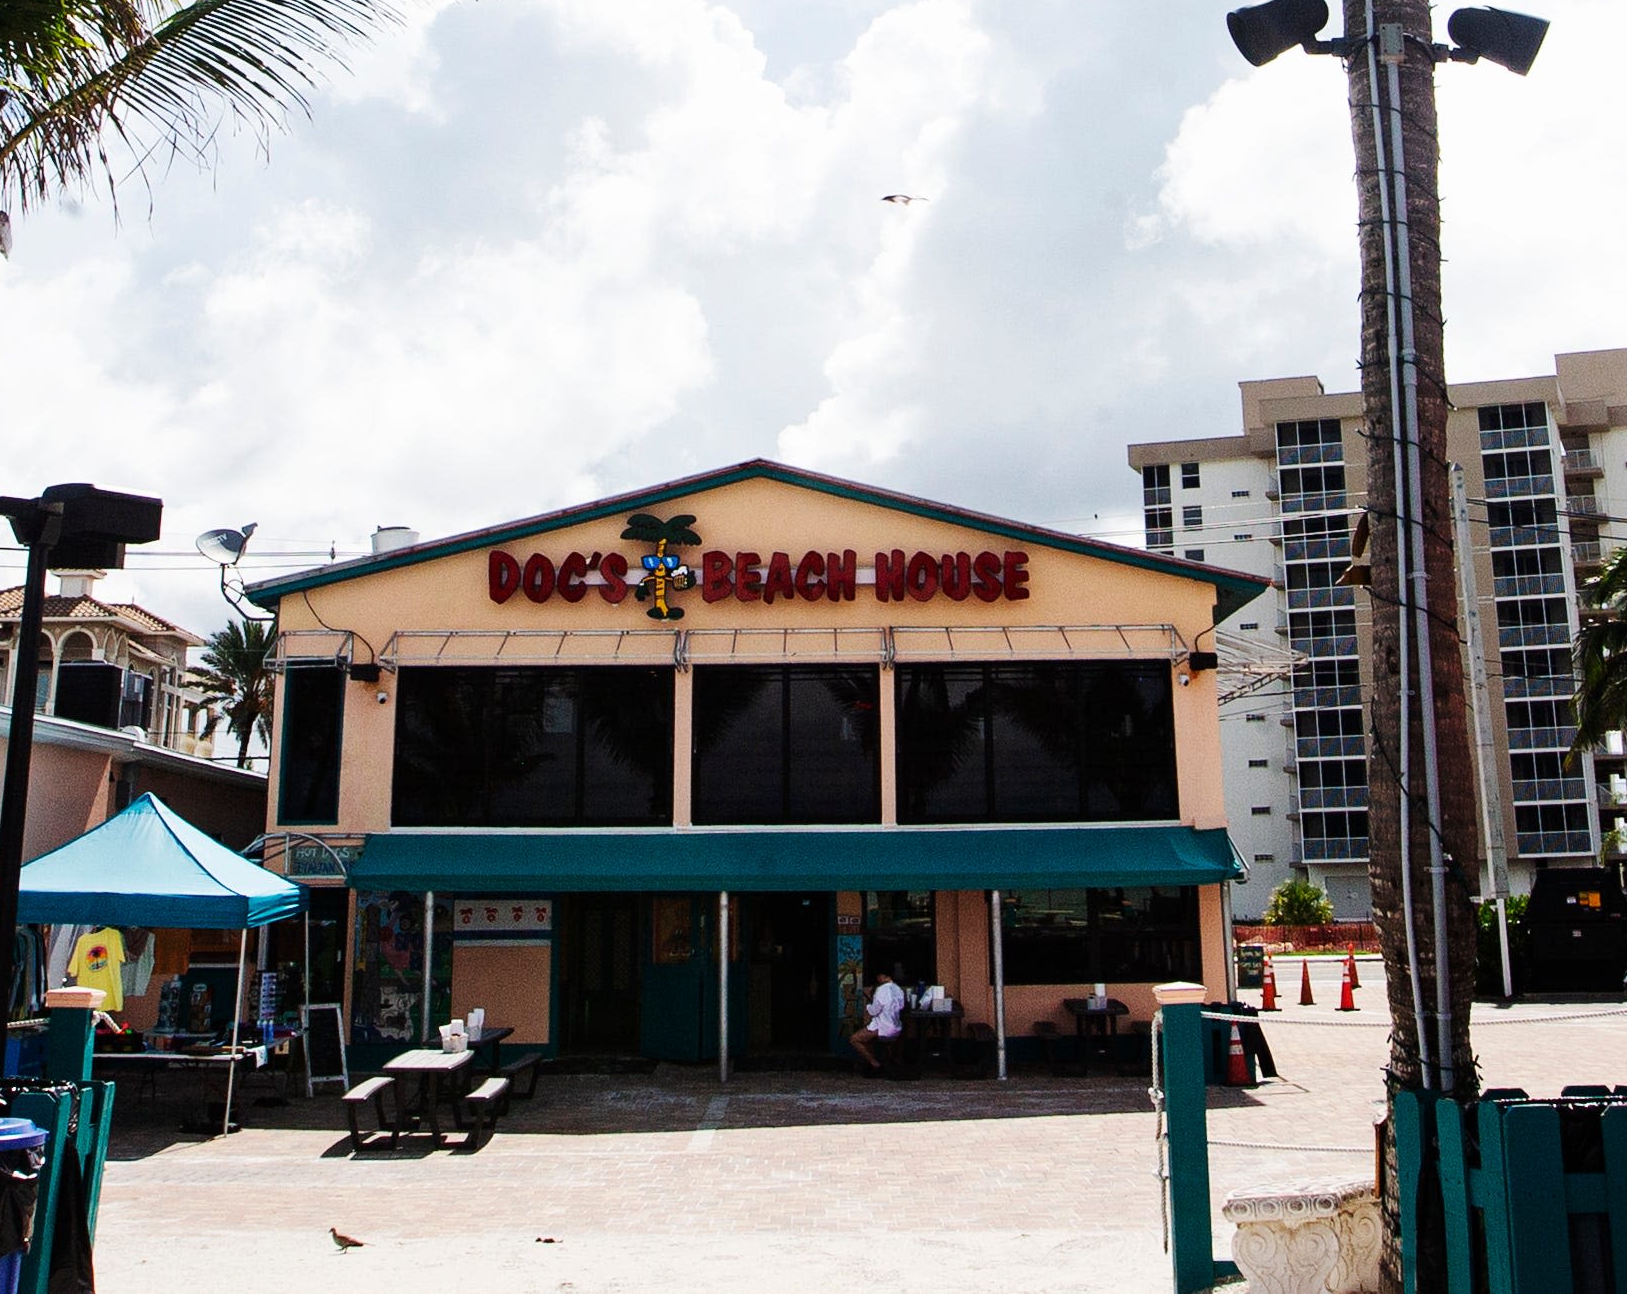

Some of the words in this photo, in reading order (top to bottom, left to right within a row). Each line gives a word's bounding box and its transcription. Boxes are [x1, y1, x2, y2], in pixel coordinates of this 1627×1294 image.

[488, 549, 628, 605] DOC'S
[701, 548, 857, 604] BEACH
[874, 549, 1030, 604] HOUSE
